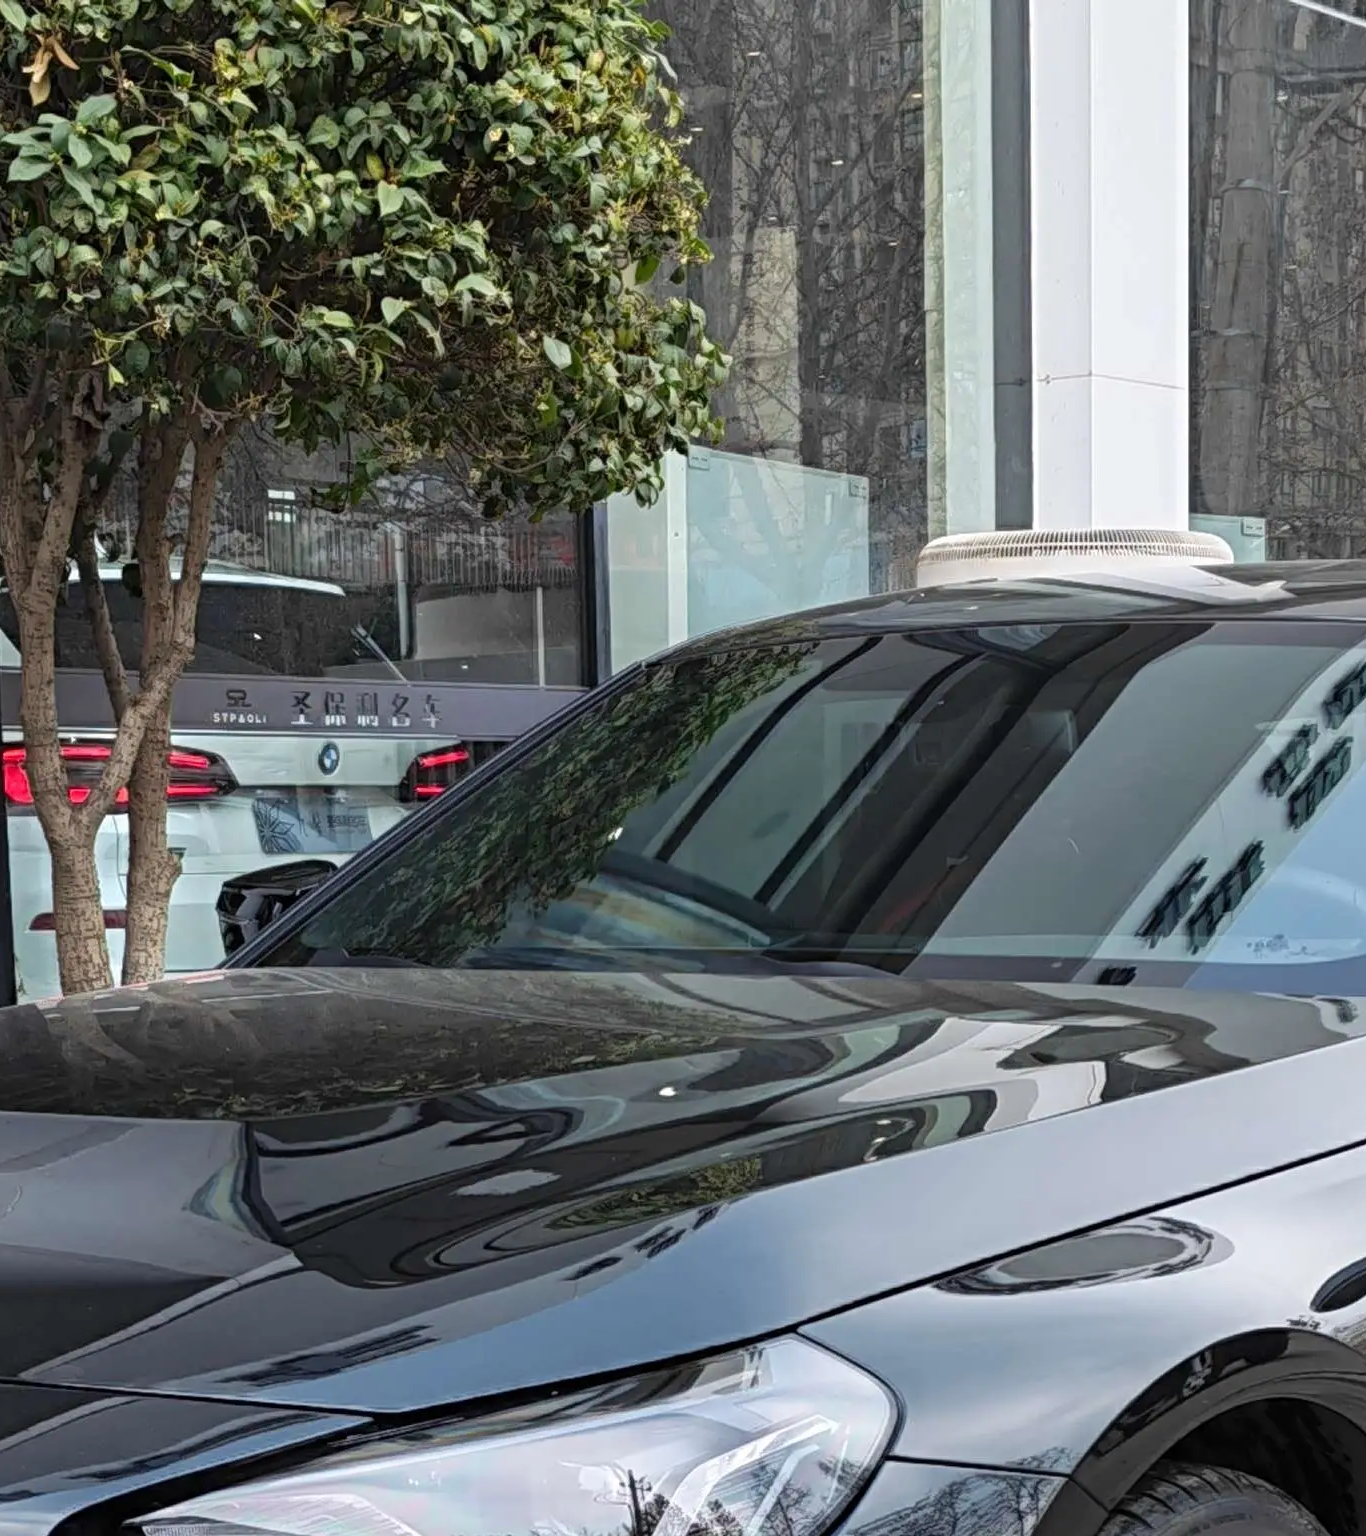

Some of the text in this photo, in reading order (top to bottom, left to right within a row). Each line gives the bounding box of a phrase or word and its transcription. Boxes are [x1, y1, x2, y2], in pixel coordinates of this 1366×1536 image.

[290, 690, 442, 728] 圣保利名车
